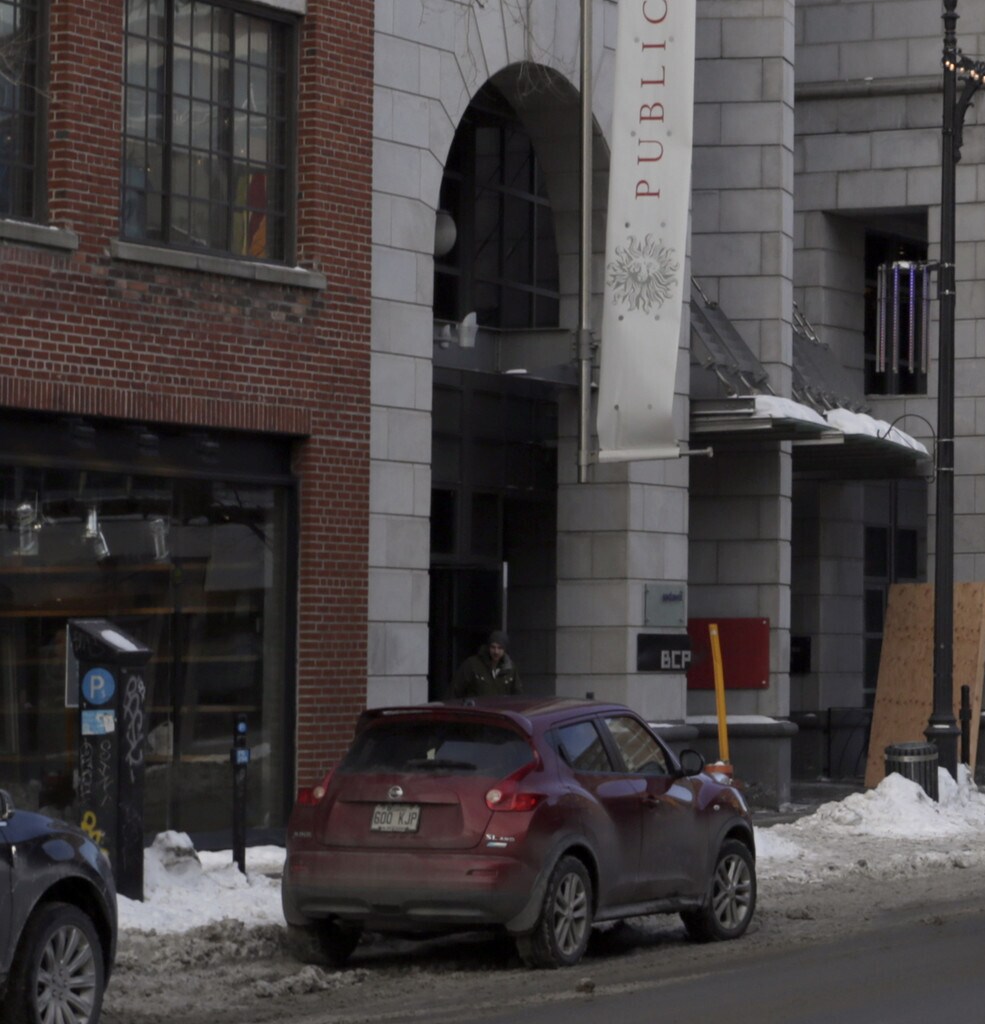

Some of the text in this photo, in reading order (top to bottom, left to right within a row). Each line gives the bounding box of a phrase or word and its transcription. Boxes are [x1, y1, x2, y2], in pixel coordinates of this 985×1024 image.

[660, 649, 692, 670] BCP
[90, 674, 106, 700] P
[373, 811, 418, 826] 600 KJP
